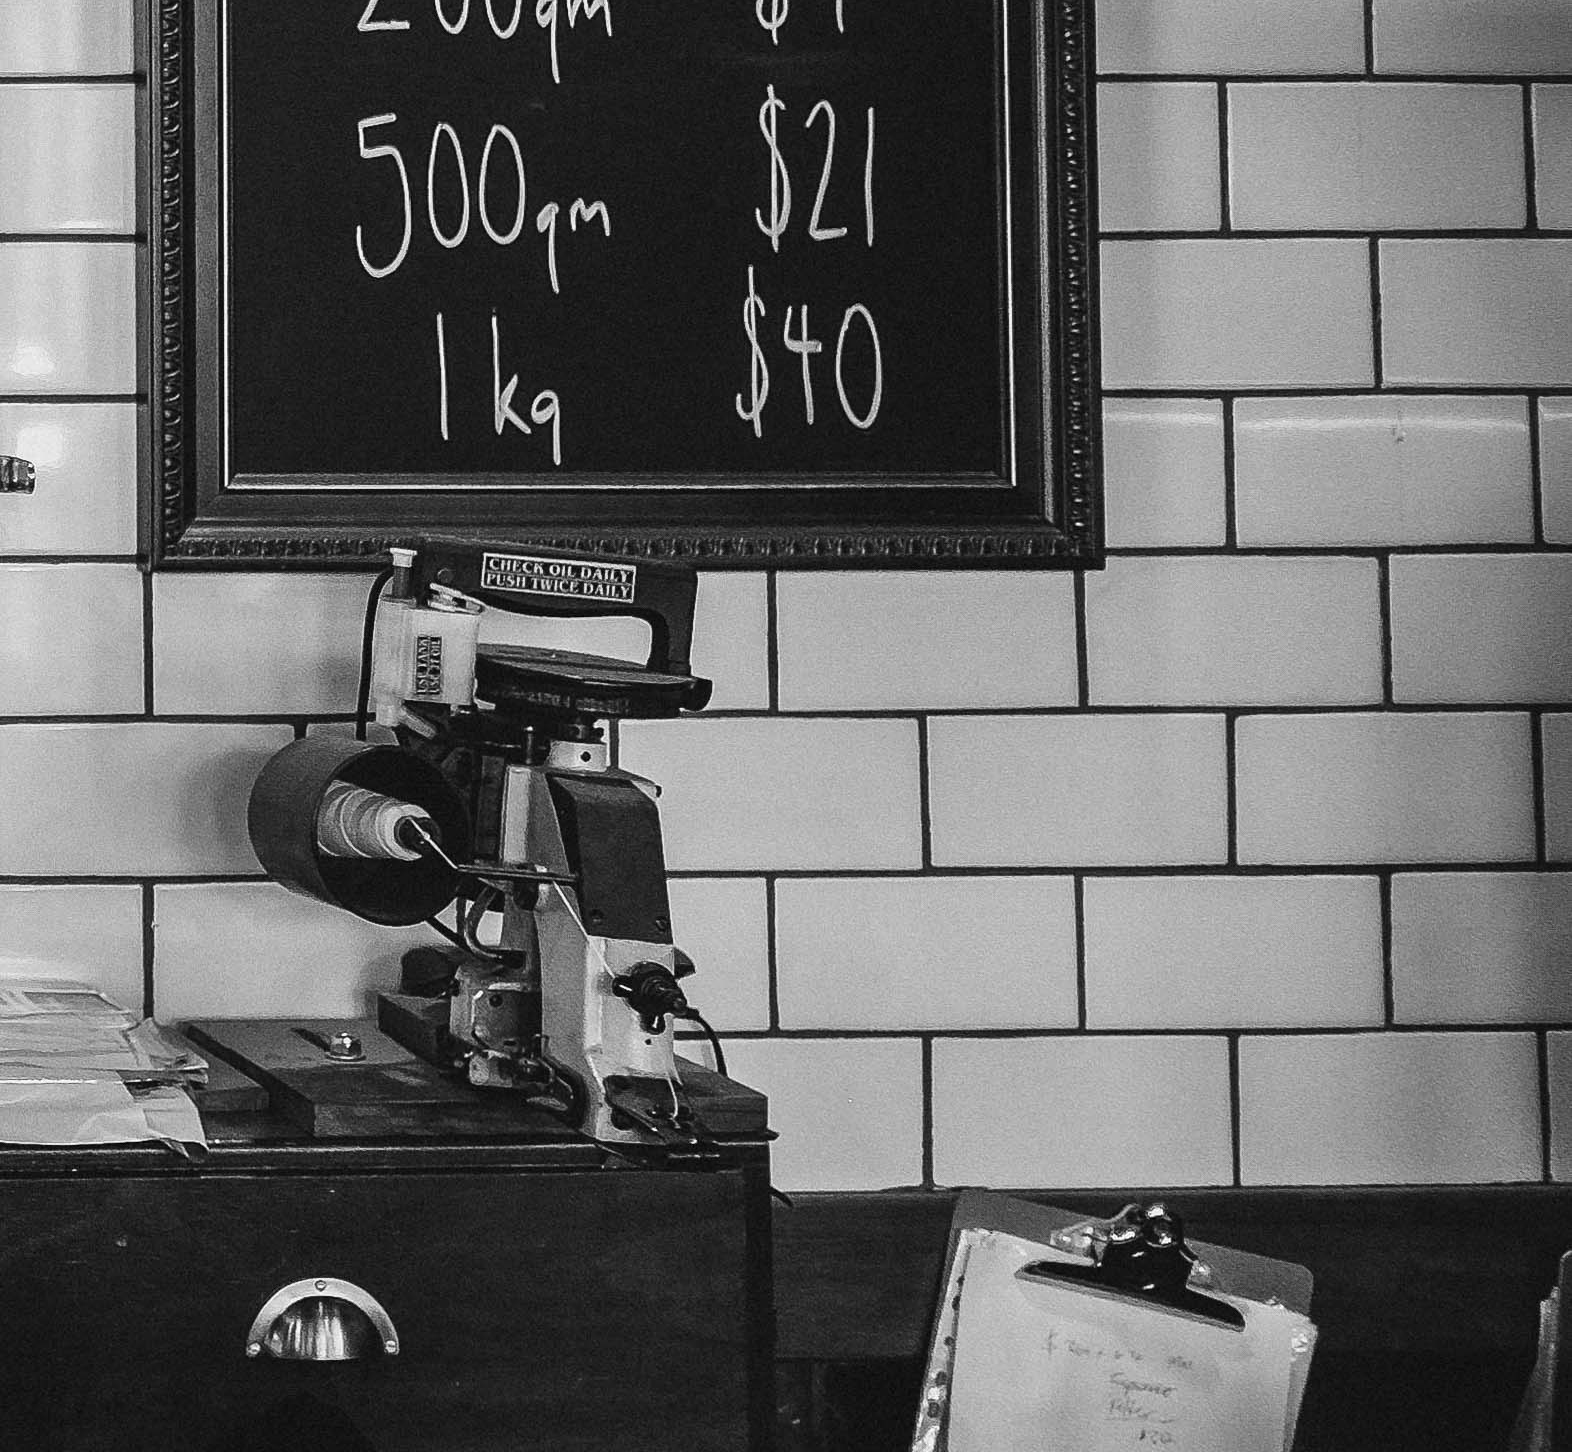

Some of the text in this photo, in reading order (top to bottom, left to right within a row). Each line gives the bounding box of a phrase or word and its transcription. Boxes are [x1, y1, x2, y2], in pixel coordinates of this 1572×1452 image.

[355, 85, 876, 293] 500gm $21
[736, 265, 883, 436] $40
[487, 573, 632, 598] PUSH TWICE DAILY
[489, 558, 630, 583] CHECK OIL DAILY
